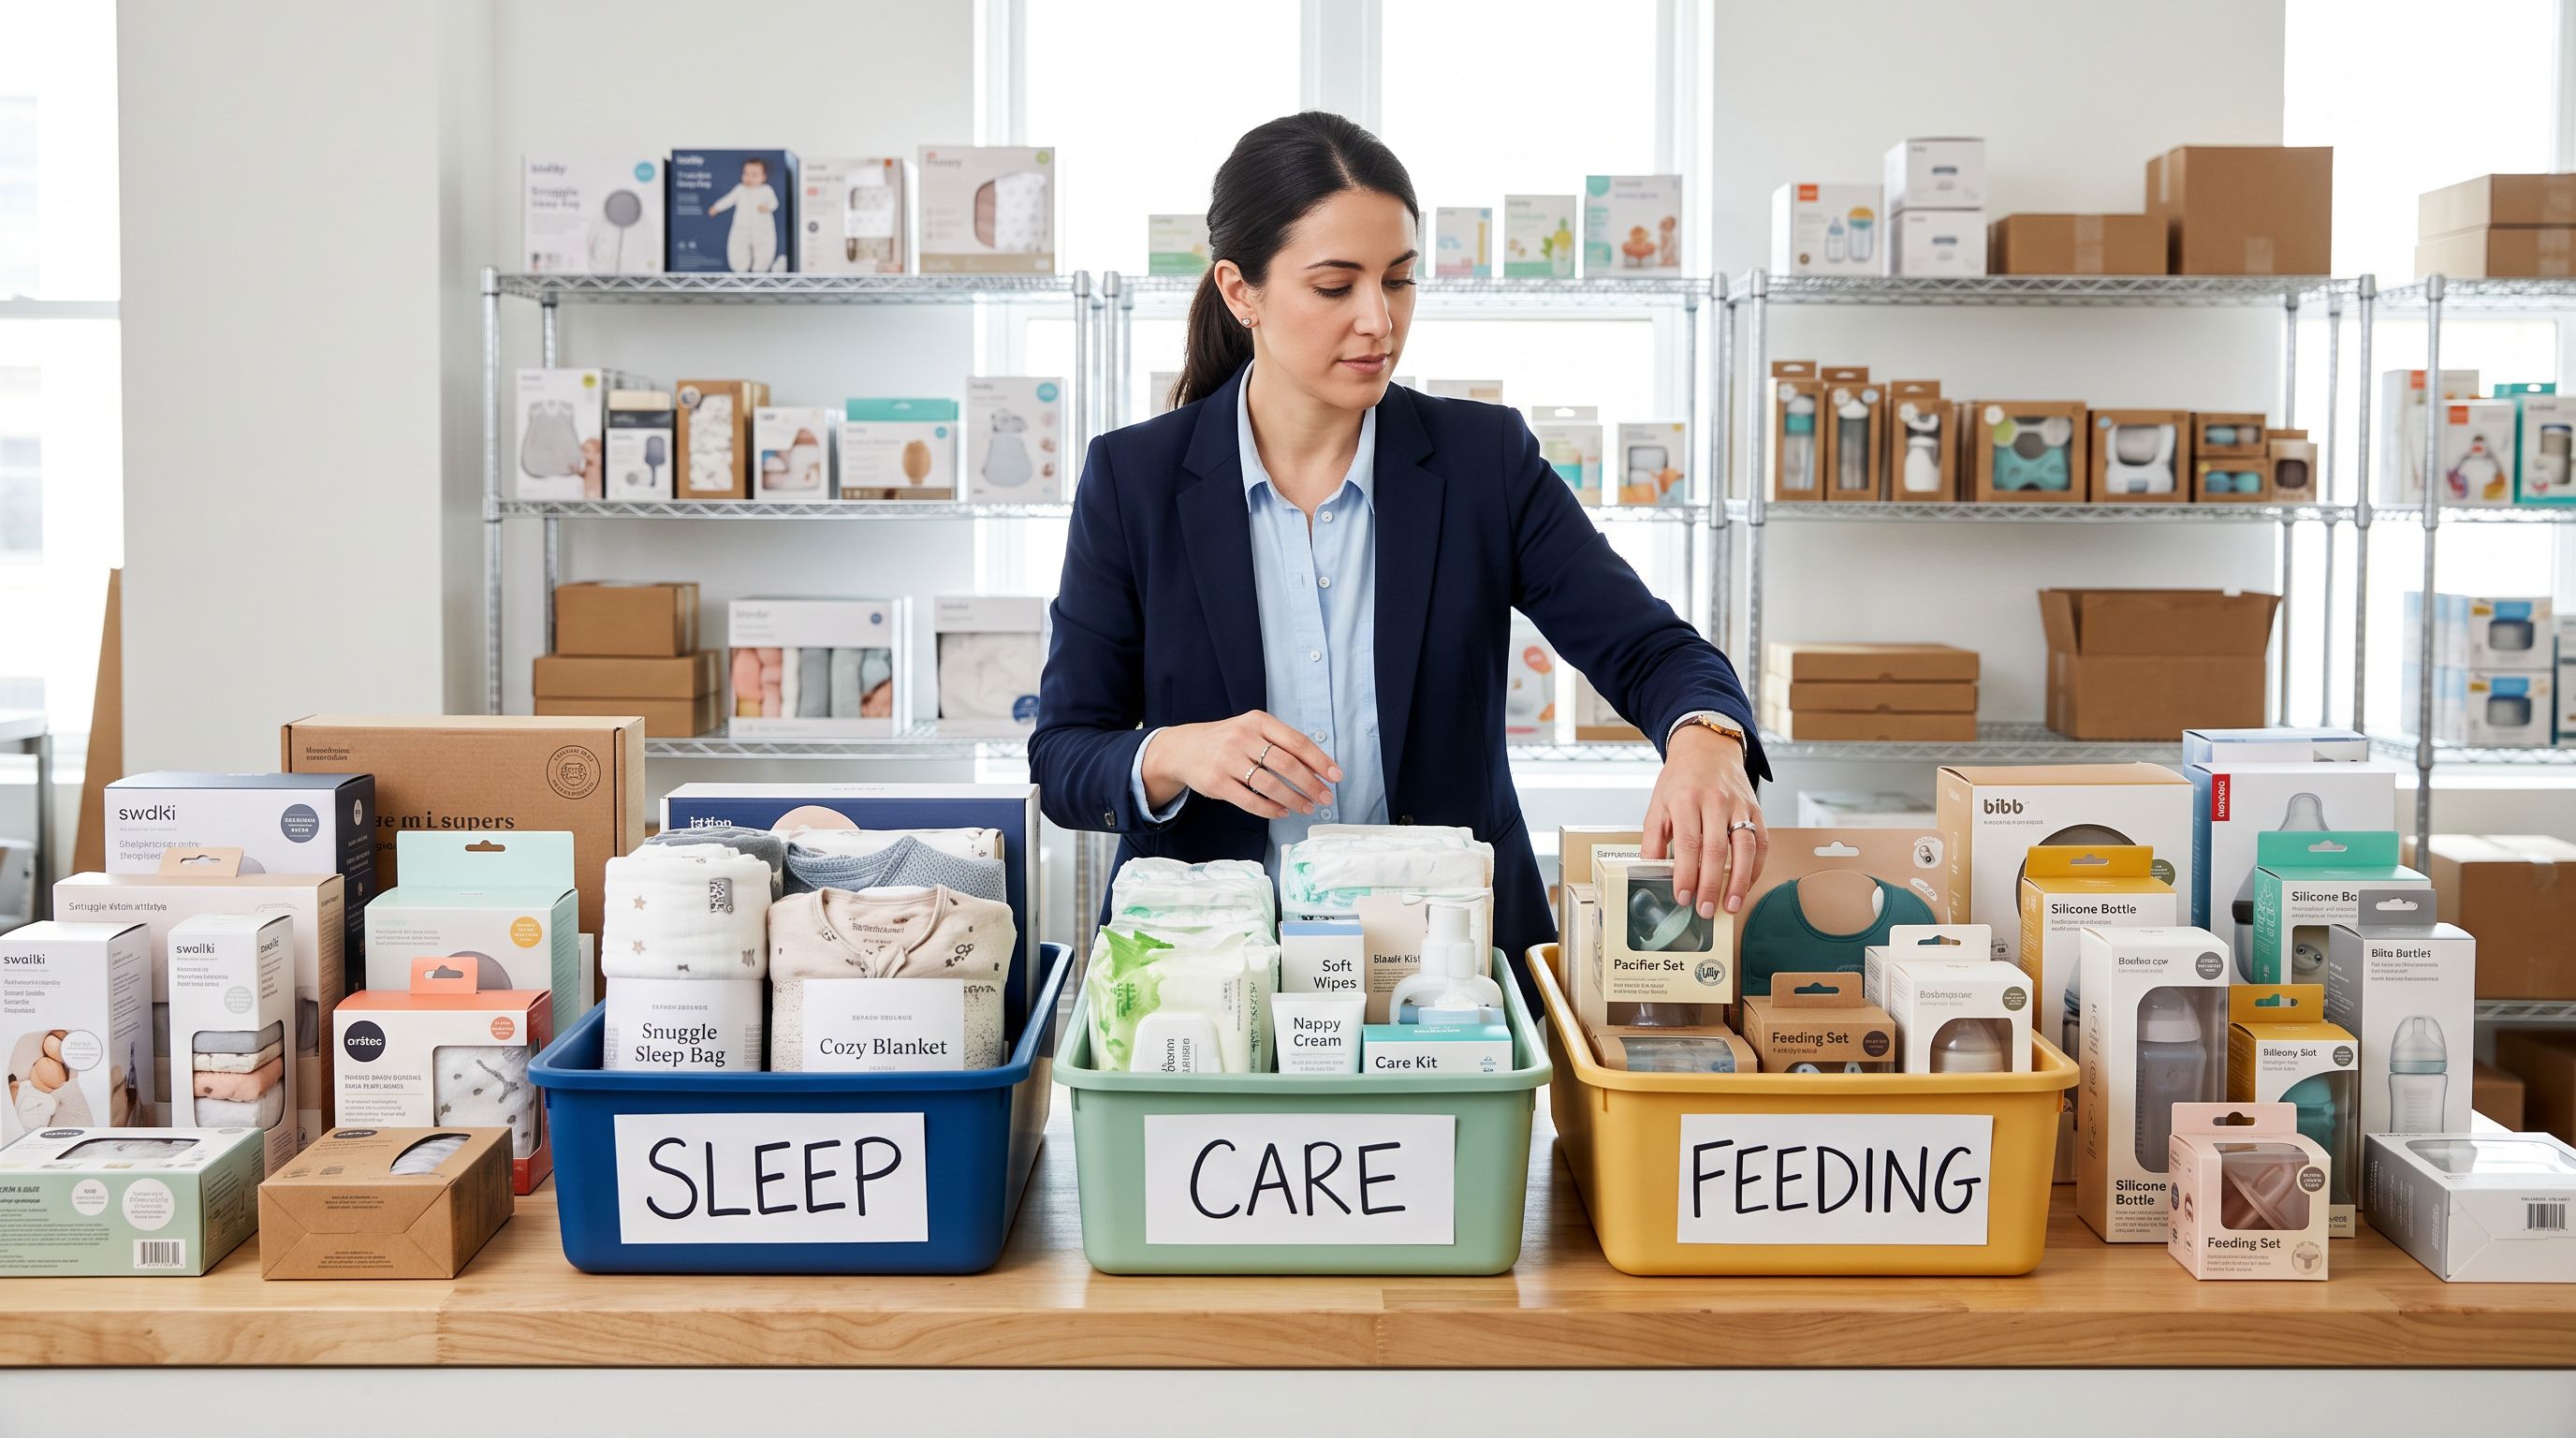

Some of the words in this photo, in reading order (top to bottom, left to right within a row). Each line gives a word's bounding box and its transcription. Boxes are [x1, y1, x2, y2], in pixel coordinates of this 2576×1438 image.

[1983, 798, 2024, 814] bibb
[441, 815, 515, 831] supers
[2292, 890, 2339, 902] Silicone
[2051, 902, 2098, 915] Silicone
[2100, 902, 2137, 915] Bottle
[4, 953, 46, 964] swailki
[1322, 959, 1353, 973] Soft
[1614, 959, 1661, 971] Pacifier
[1663, 959, 1685, 971] Set
[1313, 976, 1357, 992] Wipes
[1294, 1017, 1341, 1034] Nappy
[642, 1022, 718, 1046] Snuggle
[1294, 1034, 1341, 1047] Cream
[1772, 1032, 1824, 1048] Feeding
[1826, 1032, 1850, 1044] Set
[820, 1037, 868, 1060] Cozy
[872, 1037, 947, 1055] Blanket
[635, 1046, 684, 1068] Sleep
[689, 1046, 726, 1068] Bag
[1375, 1056, 1412, 1069] Care
[1416, 1056, 1438, 1069] Kit
[646, 1136, 902, 1220] SLEEP
[1190, 1138, 1406, 1220] CARE
[1692, 1139, 1982, 1218] FEEDING
[2115, 1179, 2167, 1192] Silicone
[2115, 1194, 2155, 1206] Bottle
[2207, 1237, 2257, 1251] Feeding
[2260, 1237, 2281, 1249] Set
